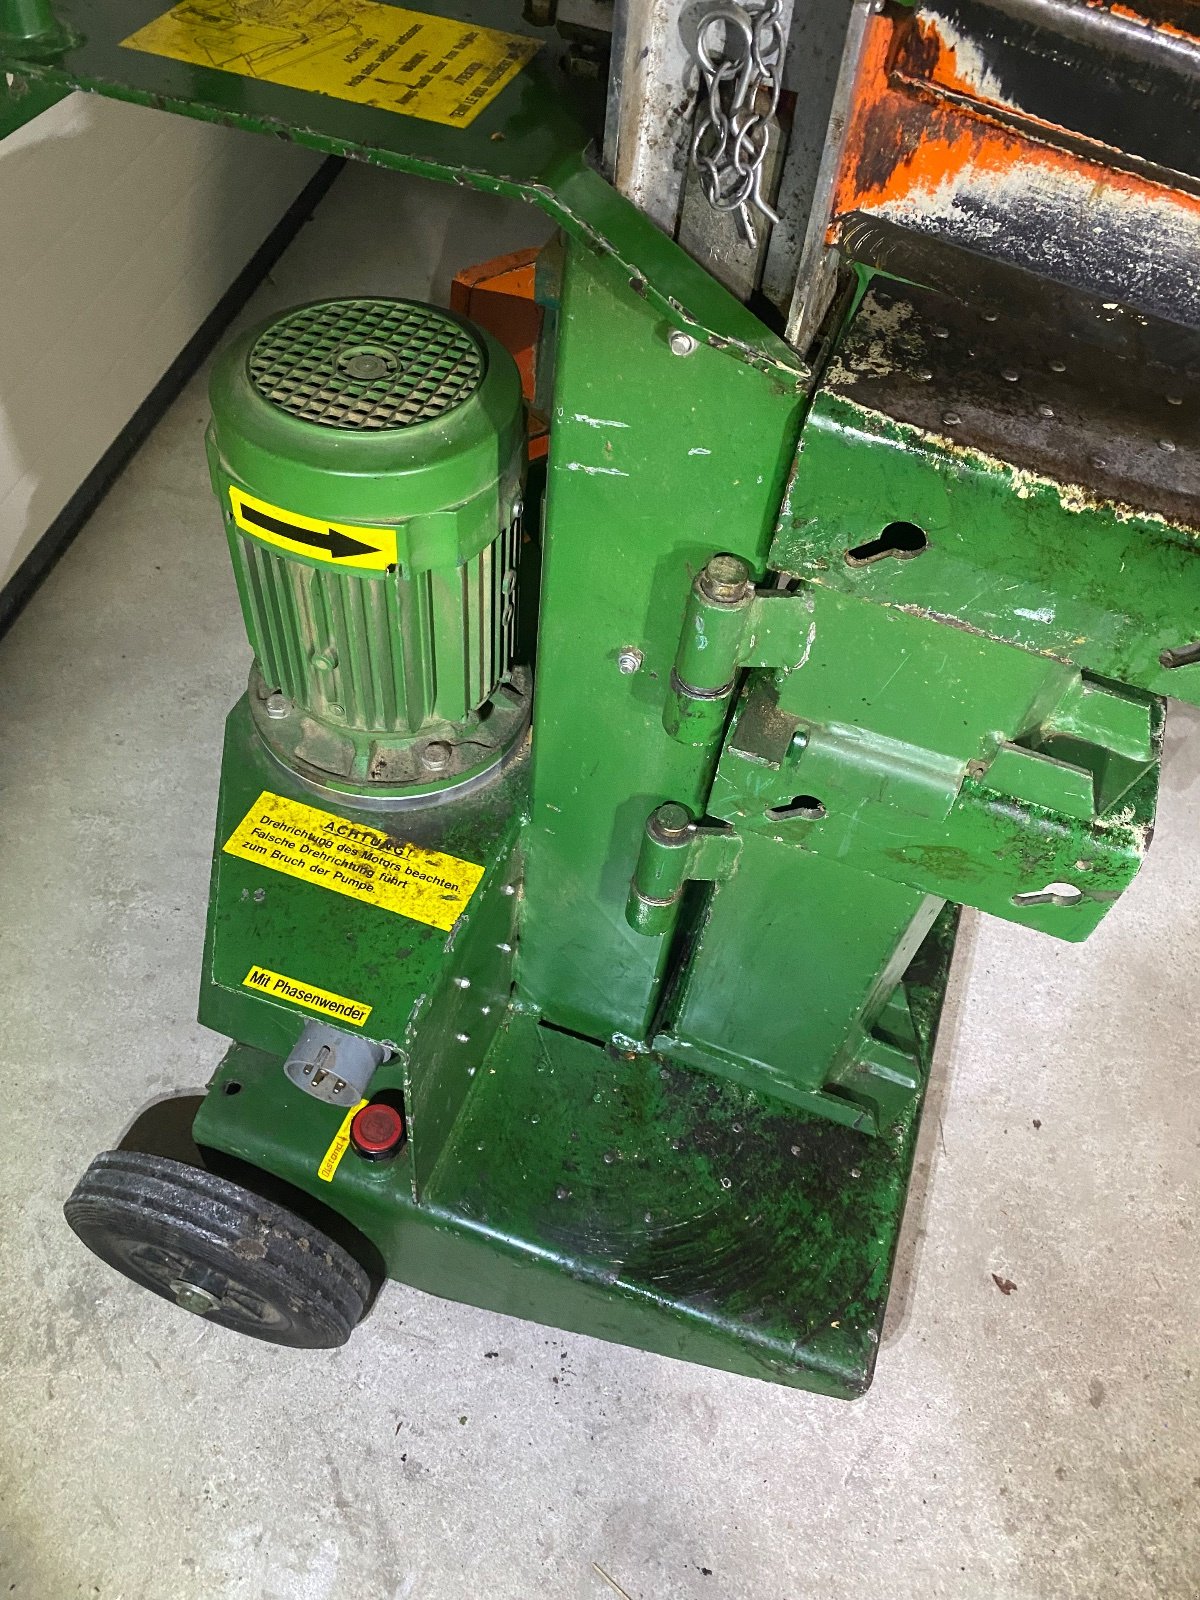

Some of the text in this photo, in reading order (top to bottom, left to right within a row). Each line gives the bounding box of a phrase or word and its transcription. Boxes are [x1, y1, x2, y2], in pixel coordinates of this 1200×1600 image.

[250, 827, 408, 889] Falsche Drehrichtung führt
[259, 815, 461, 893] Drehrichtung des Motors beachten.
[324, 821, 413, 858] ACHTUNG!
[241, 841, 375, 894] zum Bruch der Pumpe.
[249, 970, 367, 1021] Mit Phasenwender
